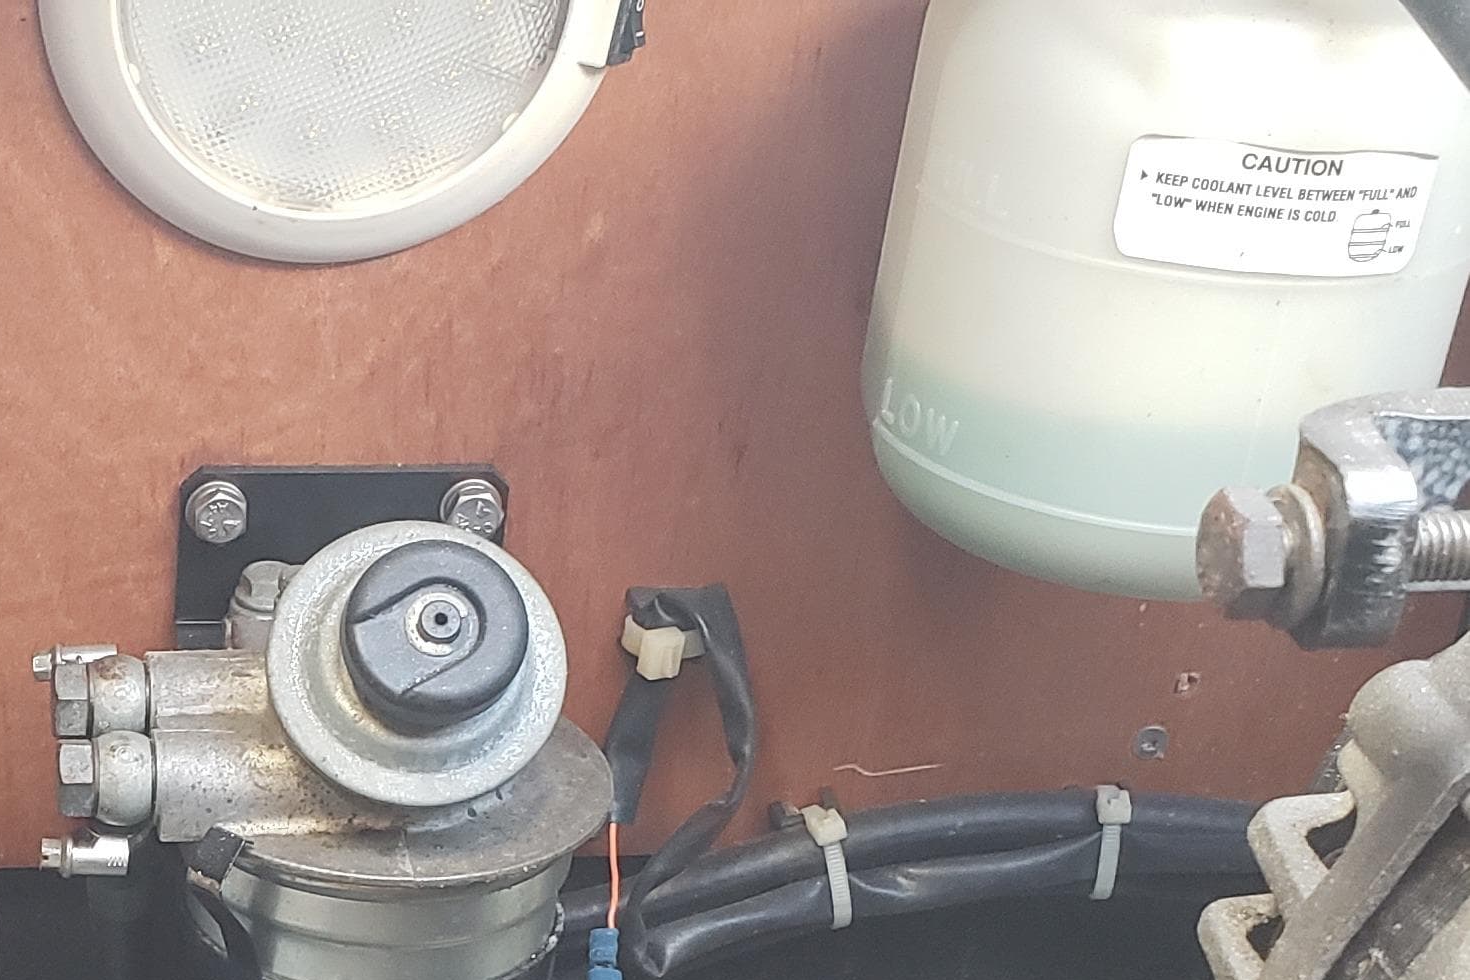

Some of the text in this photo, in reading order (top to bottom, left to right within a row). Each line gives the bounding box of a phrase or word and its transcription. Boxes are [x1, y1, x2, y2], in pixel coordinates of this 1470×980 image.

[1241, 152, 1345, 177] CAUTION
[1155, 171, 1418, 202] KEEP COOLANT LEVEL BETWEEN "FULL" AND
[1151, 192, 1193, 209] "LOW"
[1195, 199, 1235, 215] WHEN
[1236, 204, 1285, 220] ENGINE
[1287, 208, 1301, 221] IS
[880, 376, 960, 456] LOW
